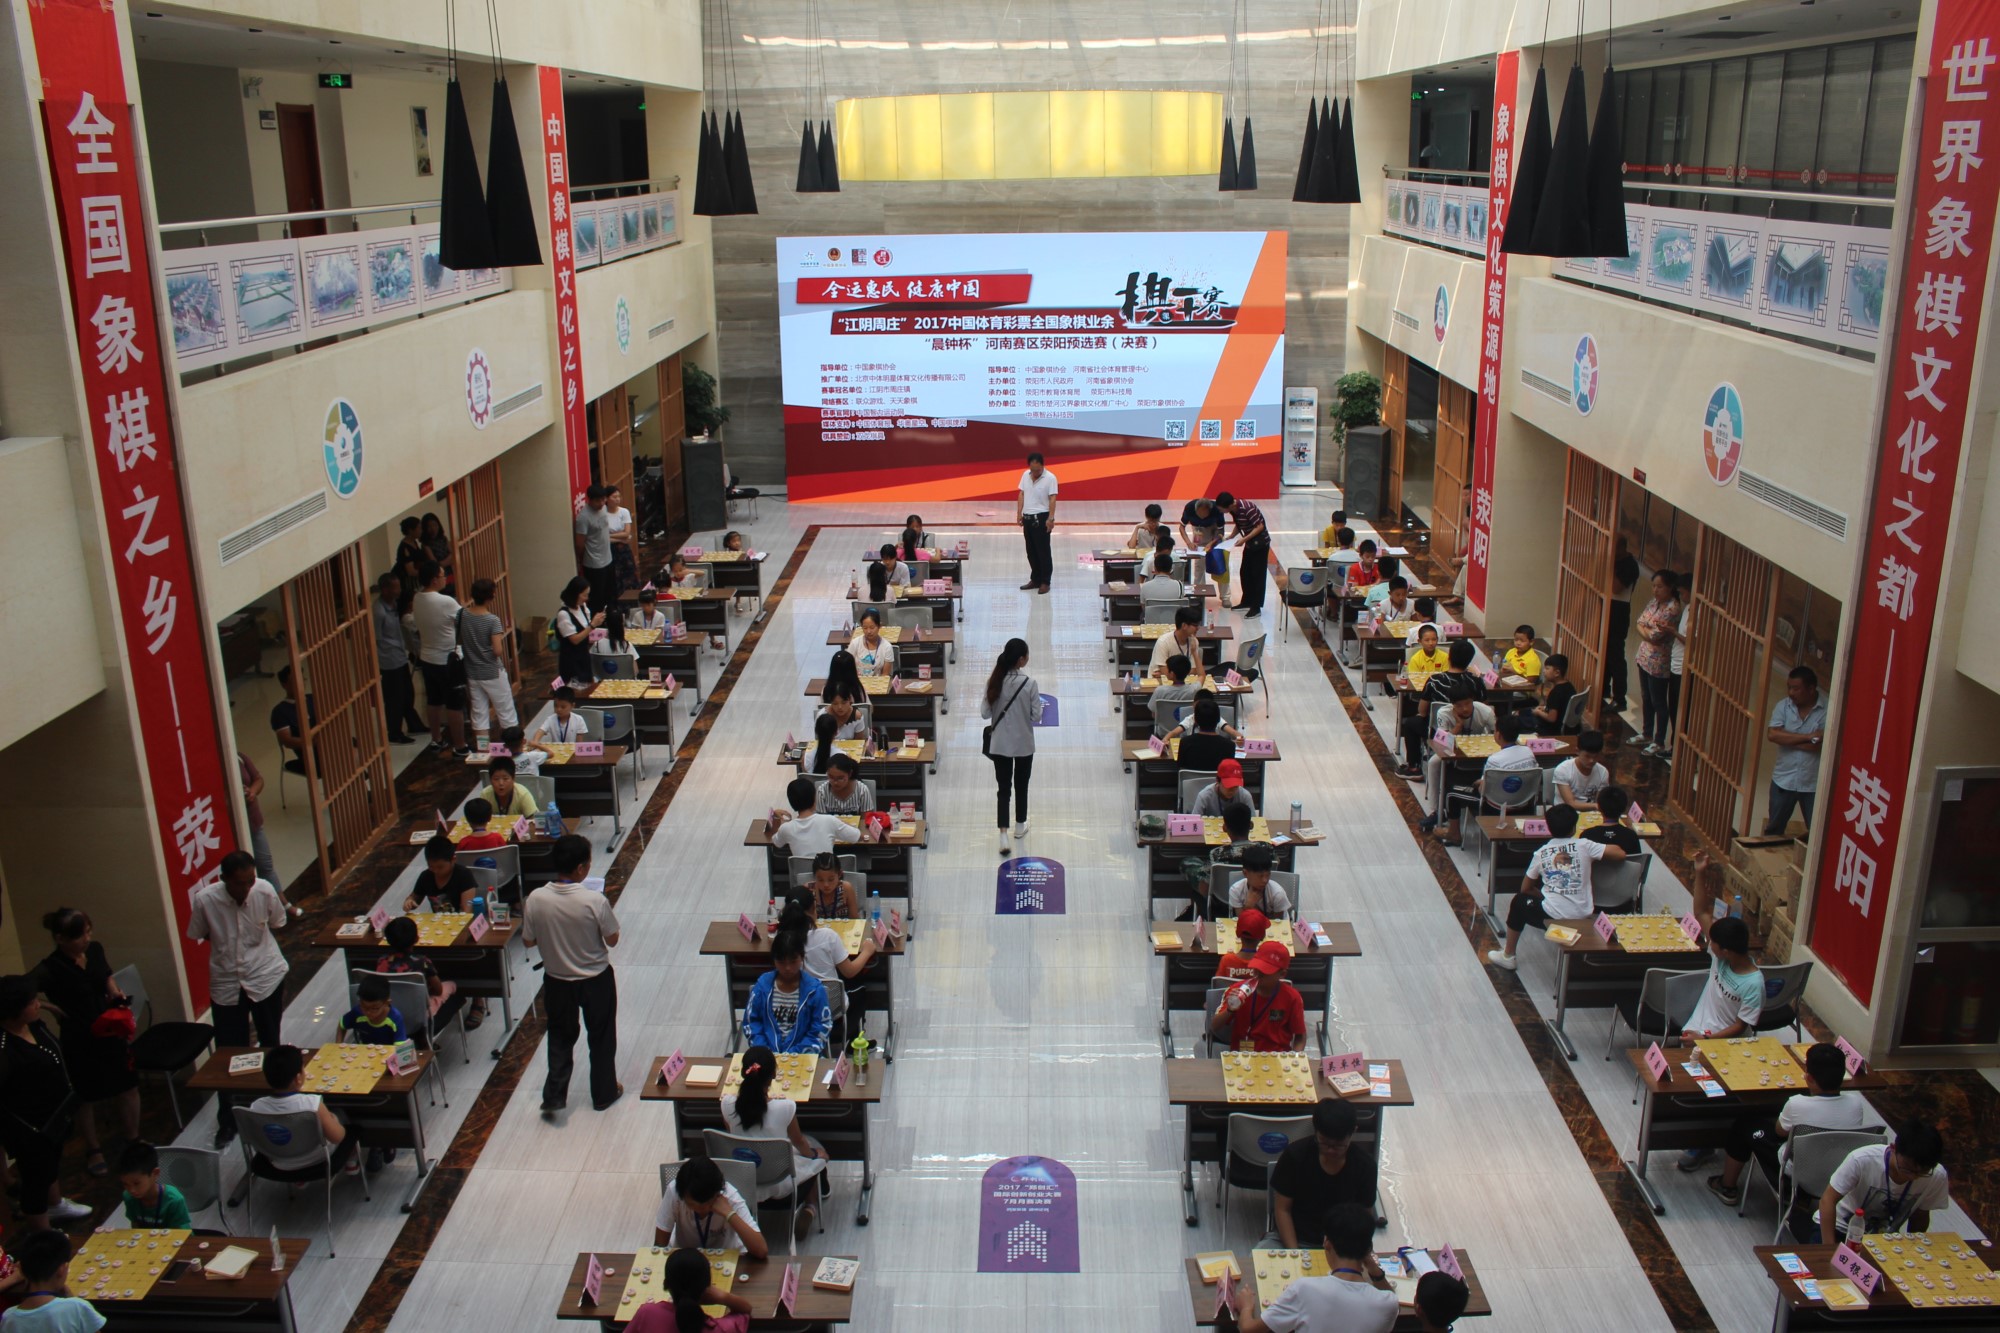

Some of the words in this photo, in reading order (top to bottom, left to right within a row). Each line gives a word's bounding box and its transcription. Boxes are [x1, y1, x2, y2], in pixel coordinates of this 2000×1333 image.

[822, 280, 900, 299] 全运惠民
[906, 279, 980, 299] 健康中国
[66, 91, 222, 944] 全国象棋之乡——荥
